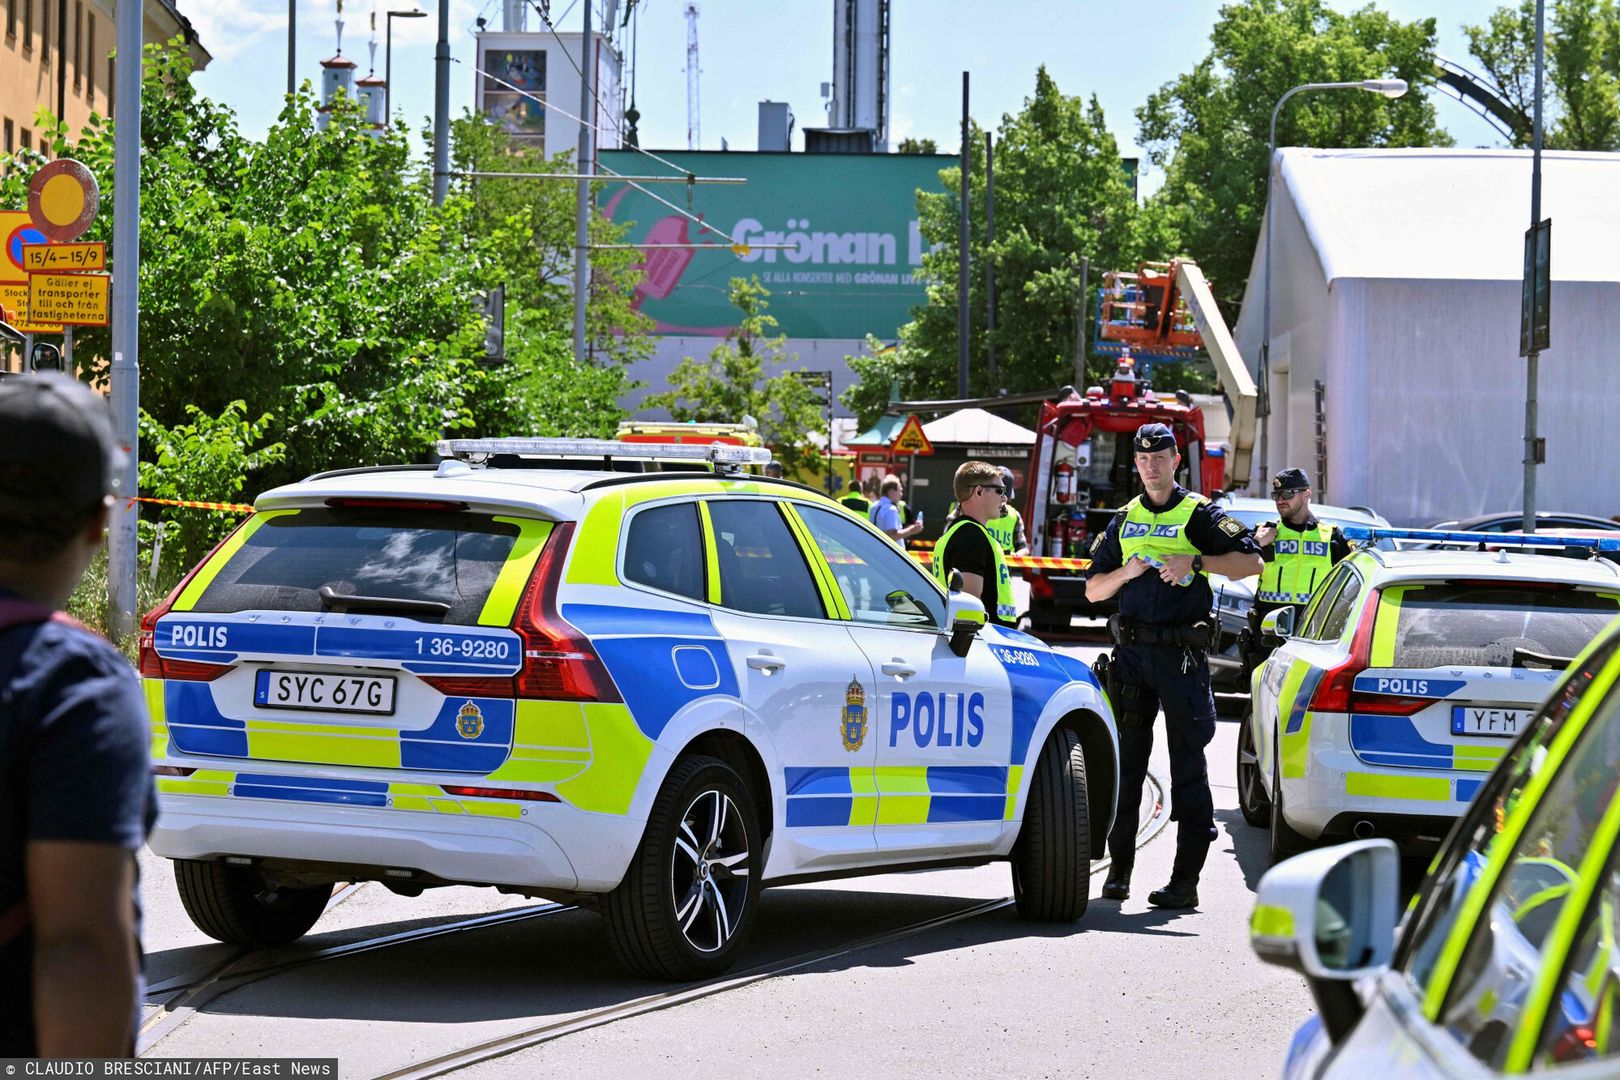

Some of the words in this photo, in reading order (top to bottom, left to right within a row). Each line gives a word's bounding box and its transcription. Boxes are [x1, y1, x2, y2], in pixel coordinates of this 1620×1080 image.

[731, 218, 897, 265] Grönan
[46, 277, 79, 287] Gäller
[83, 279, 92, 290] ej
[773, 271, 791, 283] ALLA
[835, 272, 852, 284] MED
[854, 269, 898, 284] GRÖNAN
[38, 289, 100, 300] transporter
[39, 299, 52, 308] till
[56, 300, 74, 309] och
[78, 300, 99, 310] från
[32, 309, 105, 321] fastigheterna
[1279, 540, 1324, 555] POLIS
[171, 625, 228, 648] POLIS
[415, 637, 422, 654] 1
[430, 637, 509, 659] 36-9280
[1000, 648, 1040, 667] 36-9280
[277, 676, 324, 704] SYC
[332, 679, 382, 707] 67G
[1378, 678, 1428, 695] POLIS
[889, 691, 985, 748] POLIS
[1474, 710, 1516, 732] YFM
